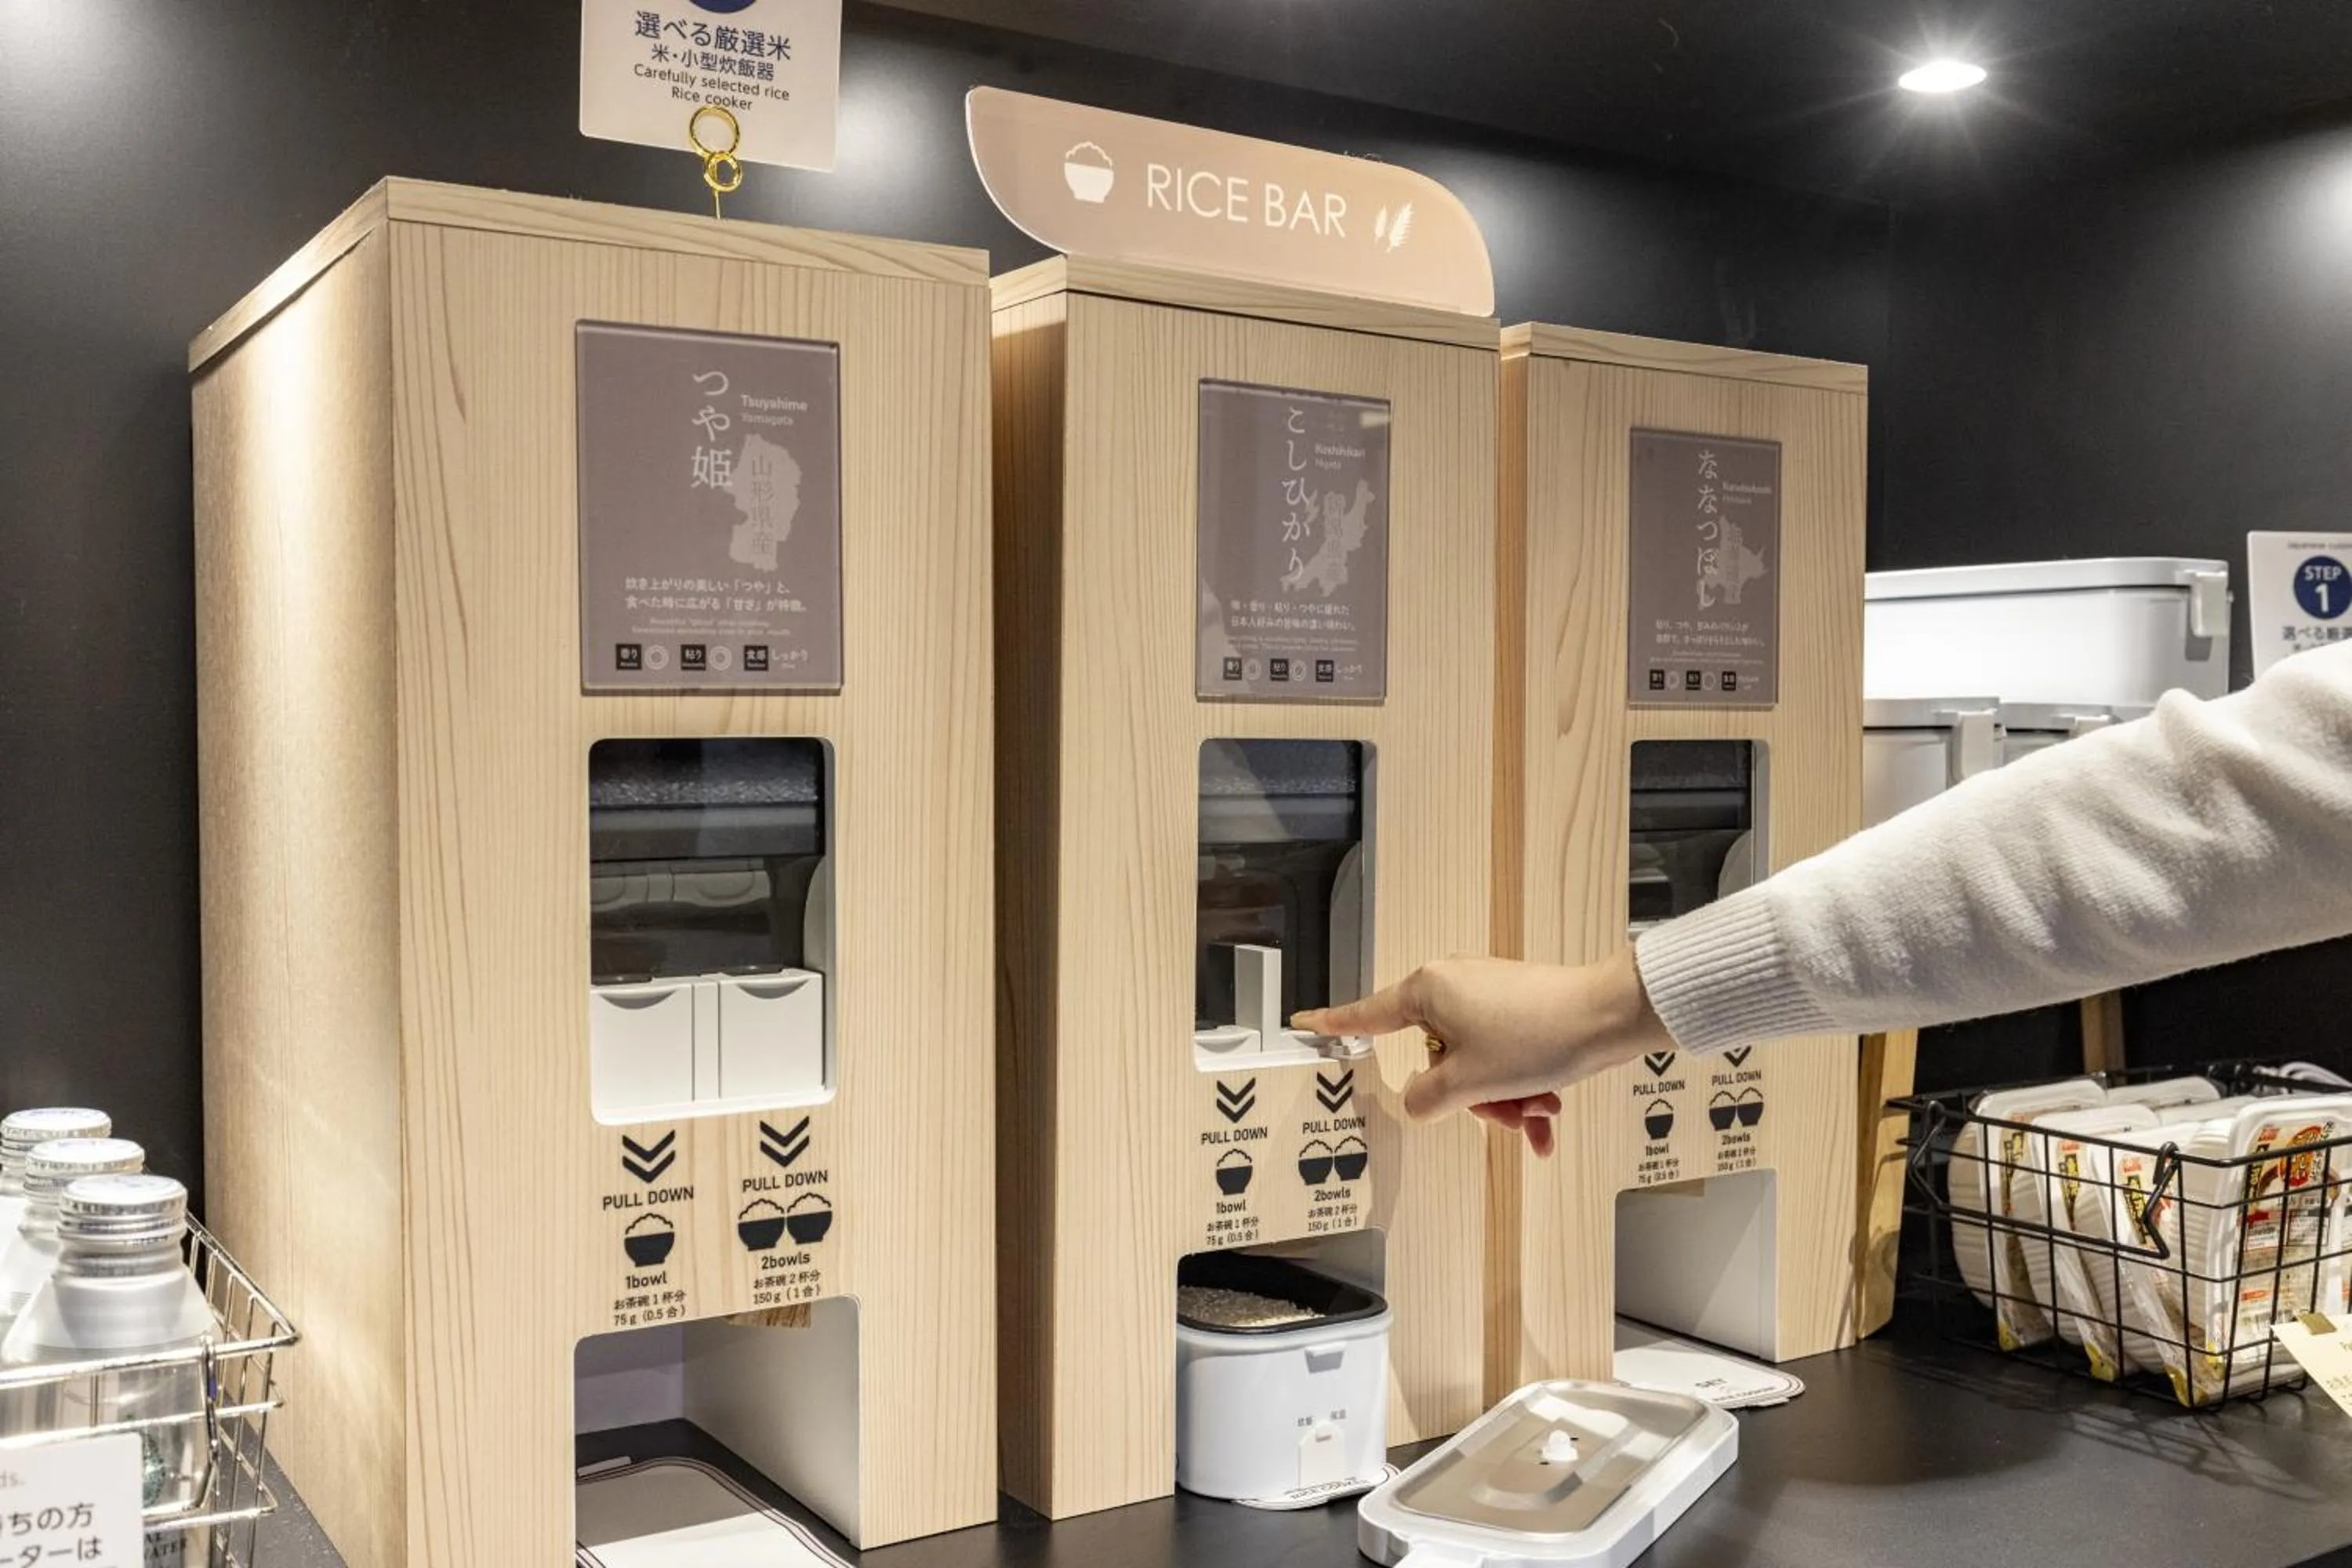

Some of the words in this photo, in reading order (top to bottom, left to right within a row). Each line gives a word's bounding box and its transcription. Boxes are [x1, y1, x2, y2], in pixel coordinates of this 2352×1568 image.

[635, 10, 791, 61] 選べる厳選米
[652, 44, 775, 82] 米・小型炊飯器
[634, 64, 696, 88] Carefully
[702, 77, 760, 96] selected
[764, 85, 789, 101] rice
[671, 86, 700, 103] Rice
[706, 93, 753, 111] cooker
[1146, 163, 1249, 223] RICE
[1265, 183, 1347, 238] BAR
[691, 370, 733, 489] つや姫
[1281, 405, 1310, 582] こしひかり
[1696, 449, 1719, 608] ななつぼし
[2303, 564, 2342, 581] STEP
[2314, 583, 2329, 613] 1
[1633, 1083, 1657, 1096] PULL
[1658, 1079, 1685, 1093] DOWN
[1711, 1073, 1734, 1086] PULL
[1736, 1069, 1762, 1083] DOWN
[1200, 1131, 1230, 1145] PULL
[1233, 1127, 1268, 1142] DOWN
[1302, 1120, 1330, 1134] PULL
[1334, 1116, 1367, 1131] DOWN
[742, 1176, 781, 1192] PULL
[785, 1170, 829, 1188] DOWN
[603, 1193, 643, 1211] PULL
[648, 1185, 695, 1205] DOWN
[1216, 1200, 1246, 1214] 1bowl
[1314, 1187, 1351, 1202] 2bowls
[761, 1253, 811, 1270] 2bowls
[625, 1271, 667, 1290] 1bowl
[0, 1501, 95, 1537] ちの方
